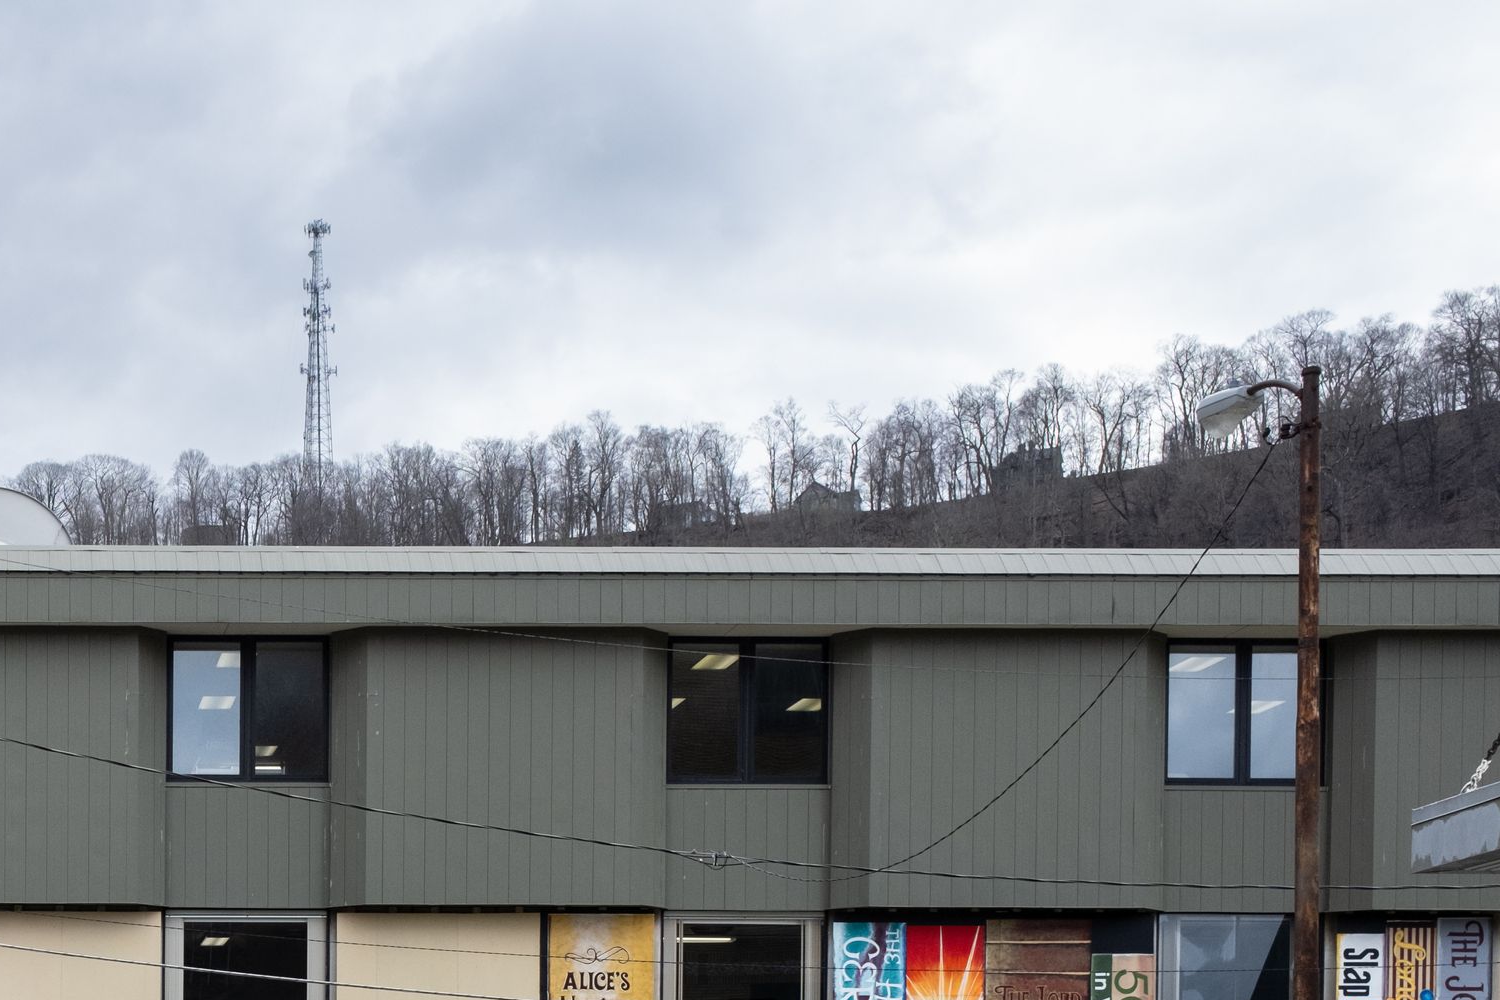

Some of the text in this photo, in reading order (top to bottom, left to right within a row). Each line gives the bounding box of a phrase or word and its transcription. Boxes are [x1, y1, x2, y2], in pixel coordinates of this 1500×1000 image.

[884, 928, 900, 965] THE
[563, 971, 631, 991] ALICE'S
[1093, 972, 1111, 990] in
